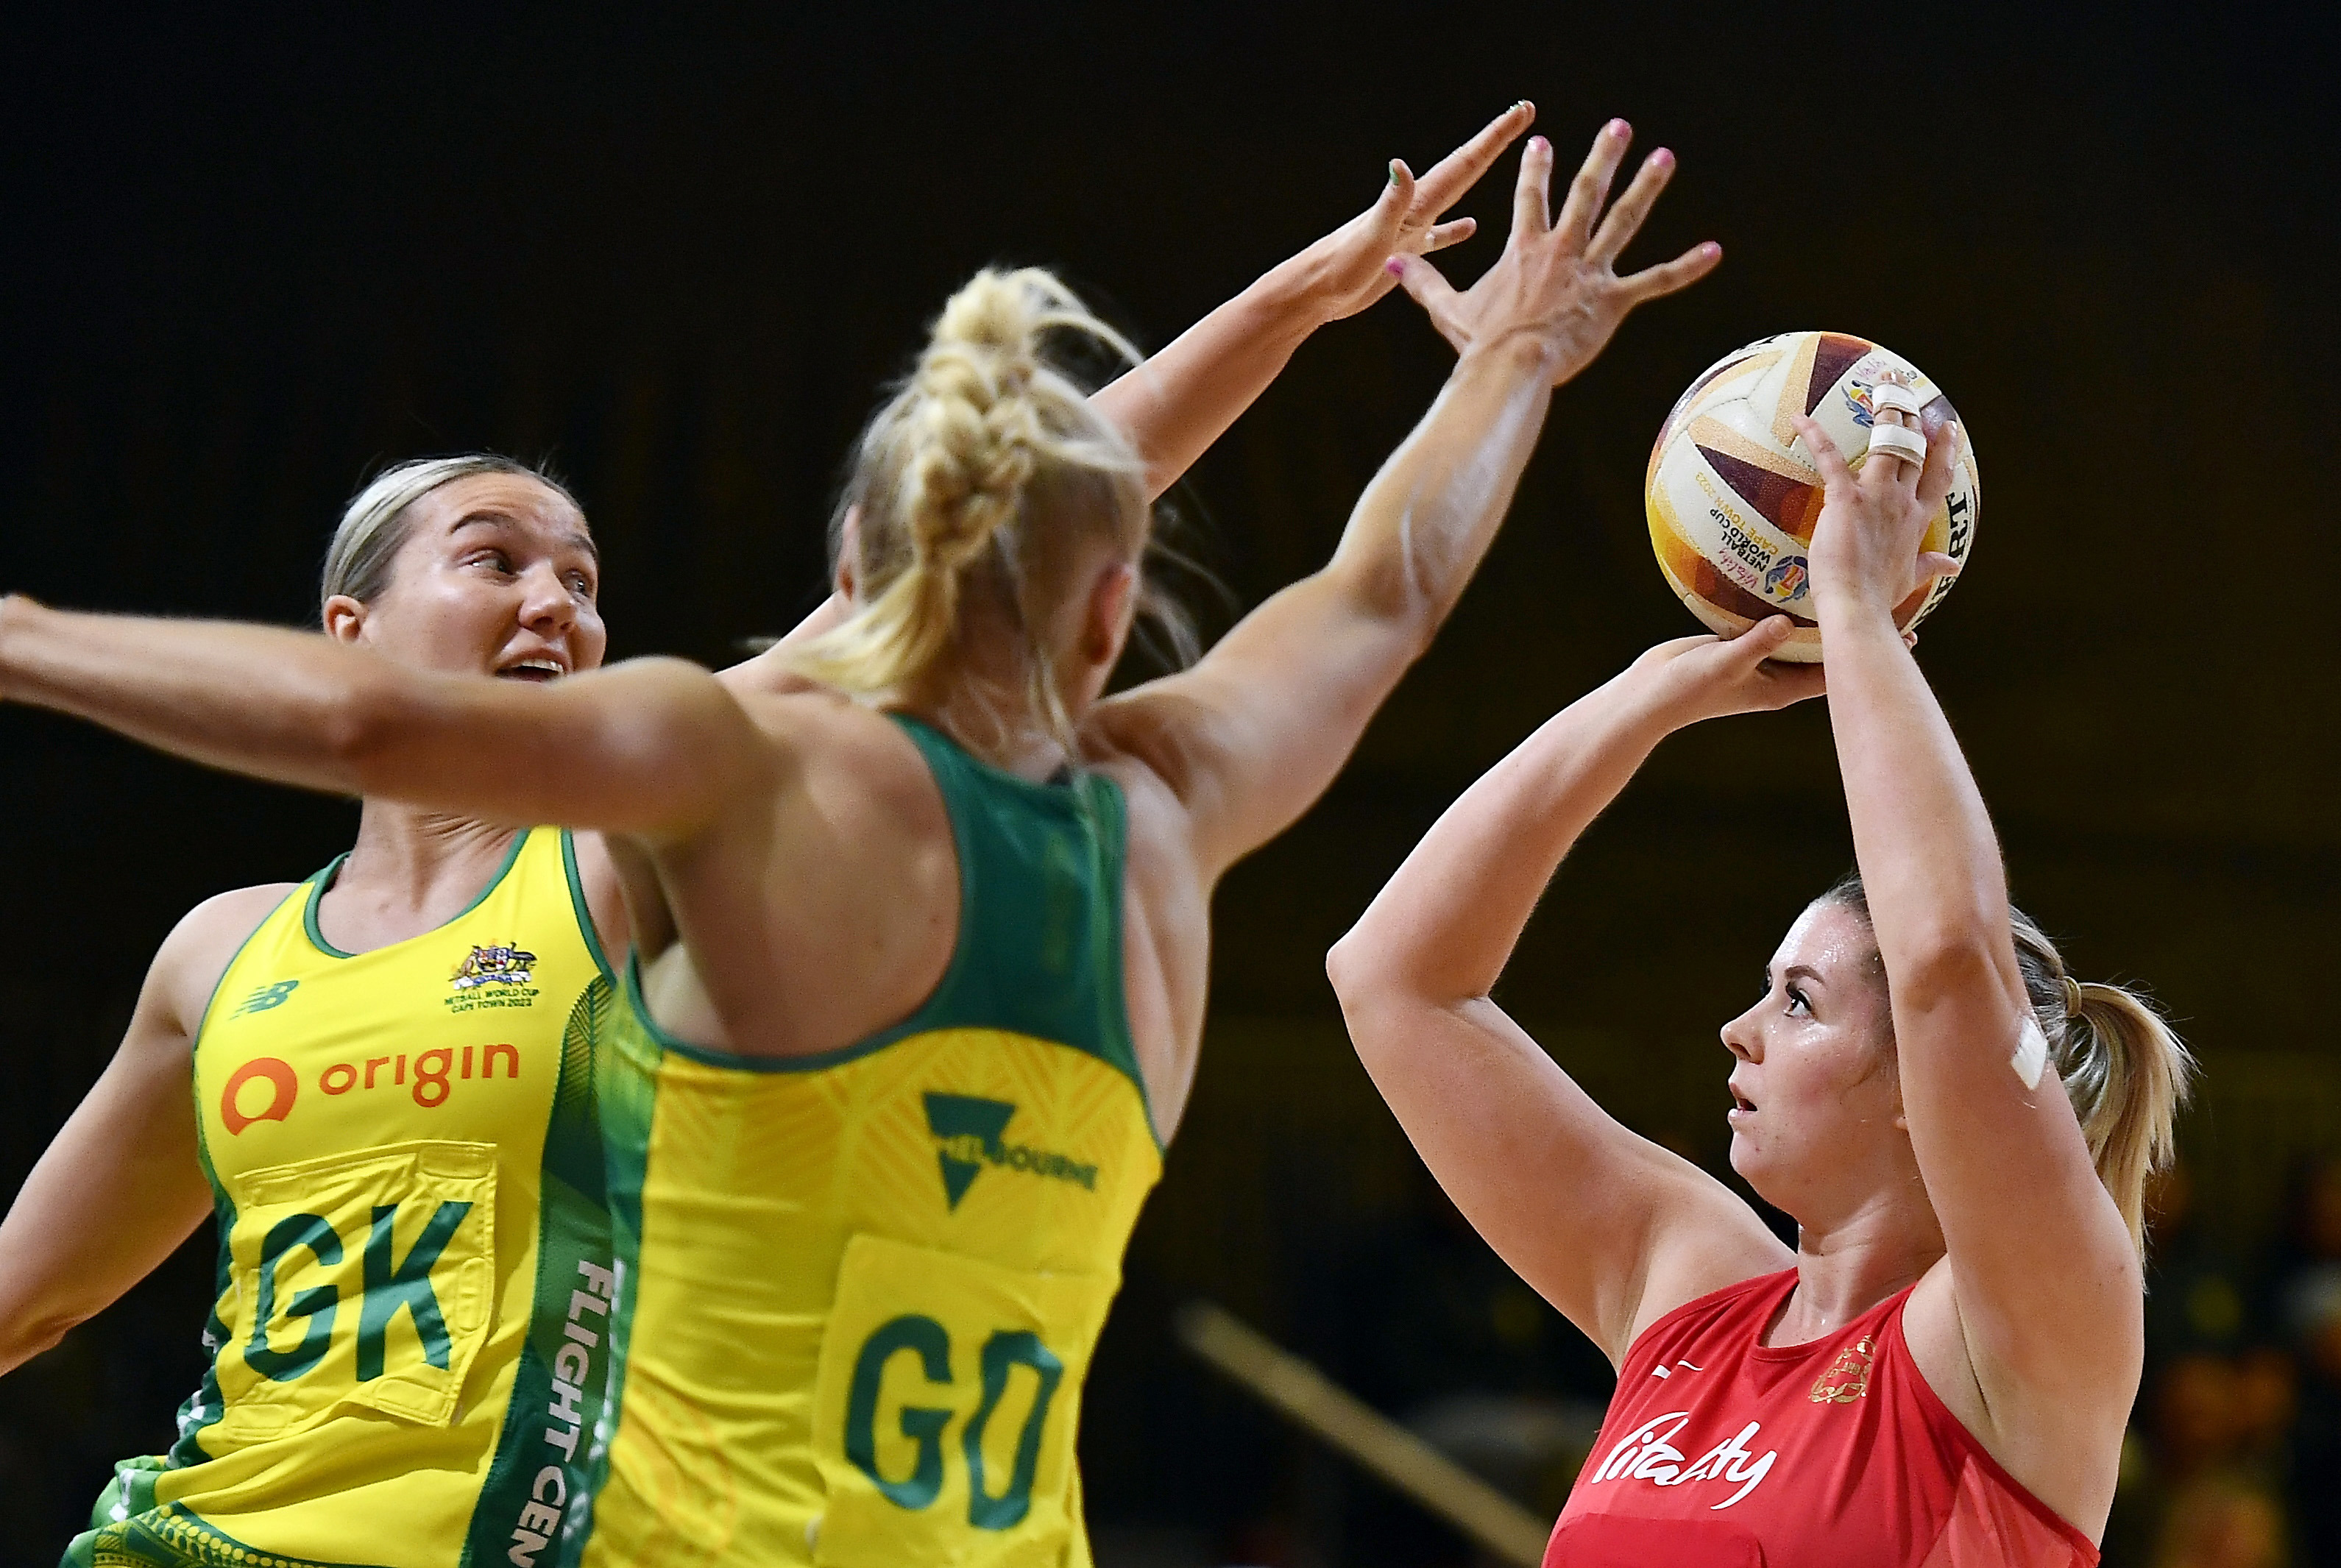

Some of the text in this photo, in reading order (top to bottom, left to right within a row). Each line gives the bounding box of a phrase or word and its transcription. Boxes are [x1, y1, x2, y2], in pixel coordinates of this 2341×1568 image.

[1710, 508, 1771, 564] WORLD CUP
[1715, 497, 1746, 530] TOWN
[1746, 528, 1779, 556] CAPE
[1721, 531, 1766, 572] NETBALL
[319, 1043, 519, 1107] origin
[244, 1201, 473, 1382] GK
[543, 1260, 613, 1464] FLIGHT
[844, 1313, 1064, 1531] GD
